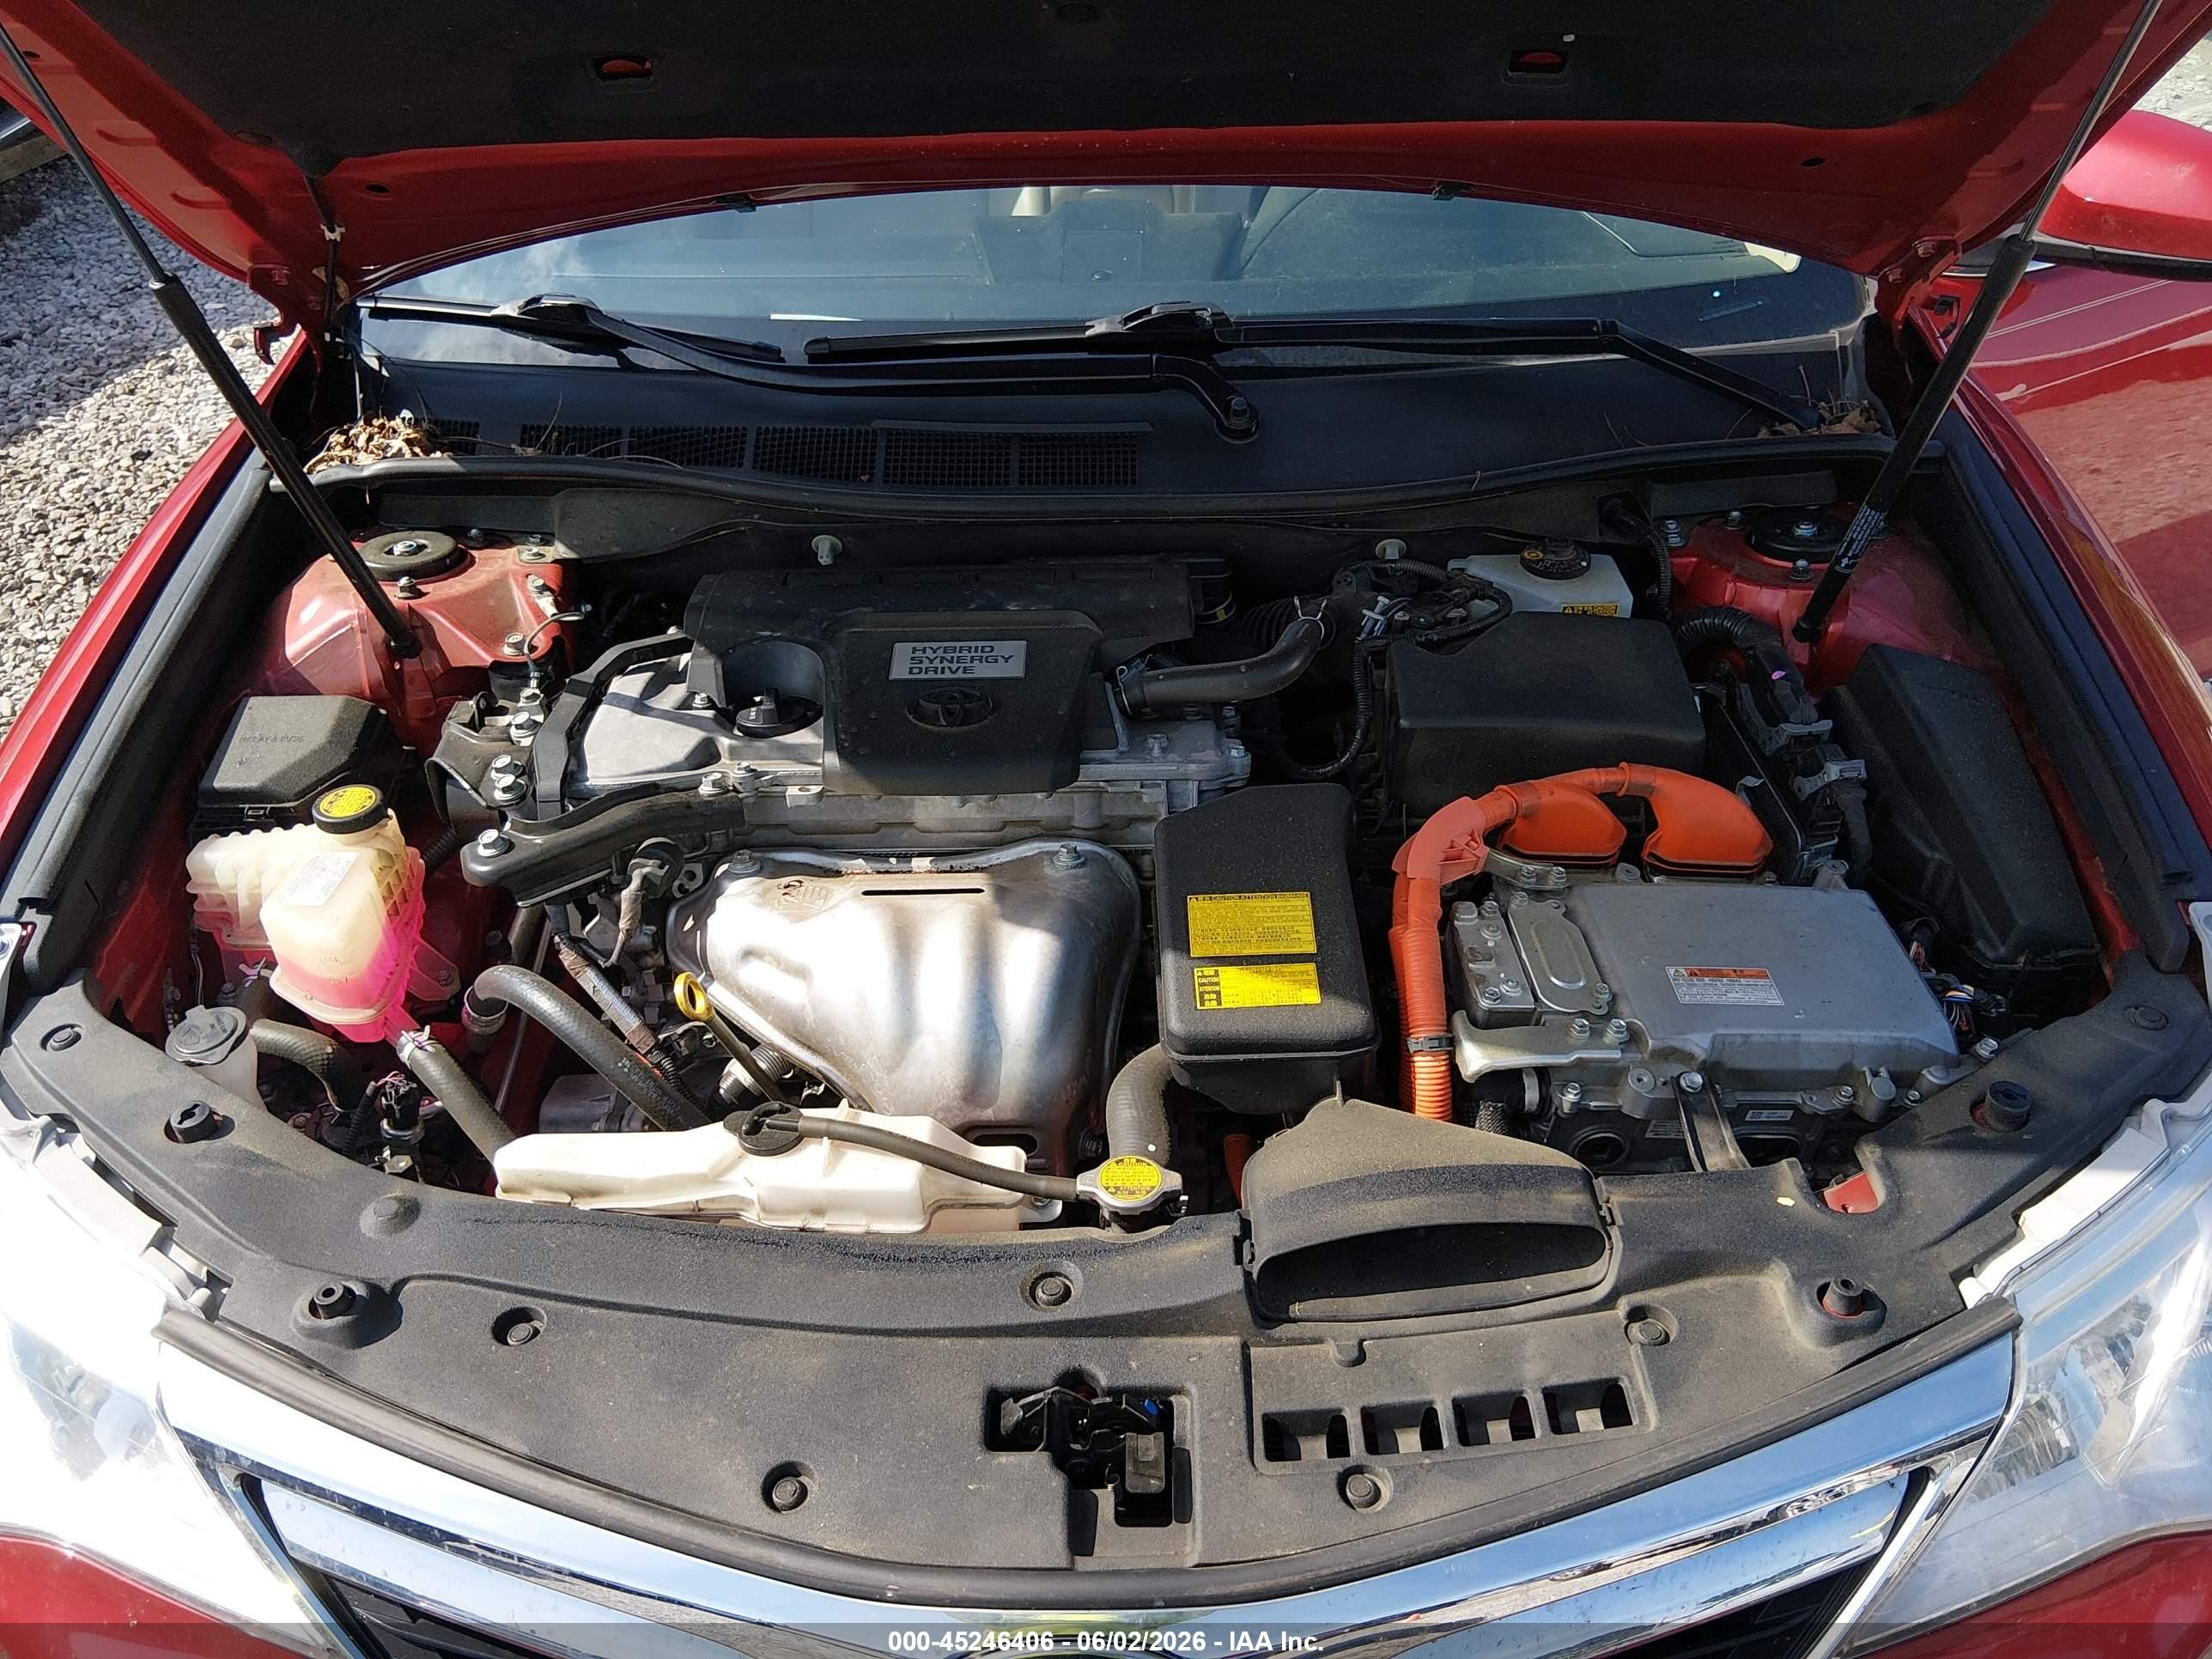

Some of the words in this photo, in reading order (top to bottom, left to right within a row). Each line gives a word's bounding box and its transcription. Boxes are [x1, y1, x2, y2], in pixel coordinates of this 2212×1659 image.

[911, 645, 995, 654] HYBRID
[909, 654, 1015, 665] SYNERGY
[908, 666, 975, 675] DRIVE
